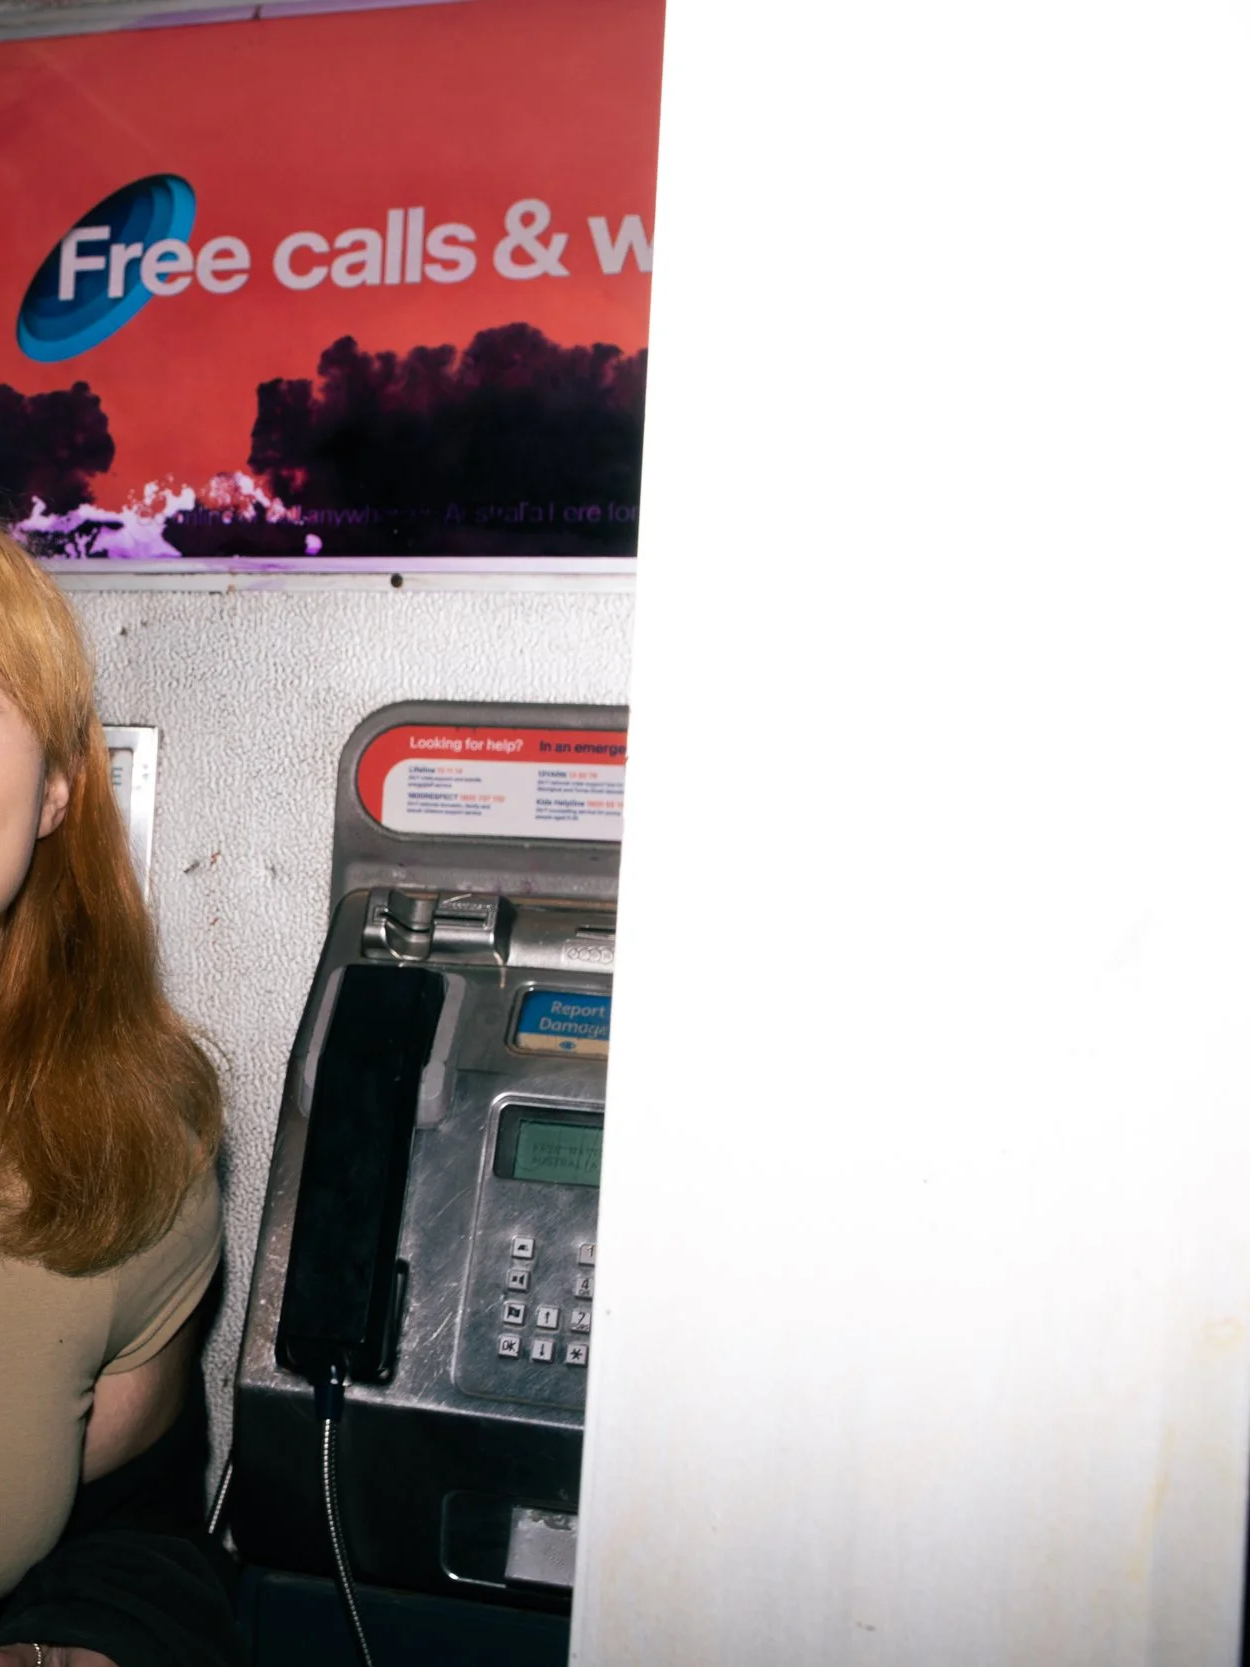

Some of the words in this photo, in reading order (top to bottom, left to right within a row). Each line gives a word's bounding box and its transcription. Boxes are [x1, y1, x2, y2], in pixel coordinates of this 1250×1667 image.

[58, 223, 250, 300] Free
[273, 206, 476, 290] calls
[493, 198, 569, 279] &
[410, 737, 463, 752] Looking
[465, 738, 484, 750] for
[486, 739, 524, 754] help?
[540, 740, 552, 752] In
[555, 743, 571, 752] an
[551, 1001, 606, 1018] Report
